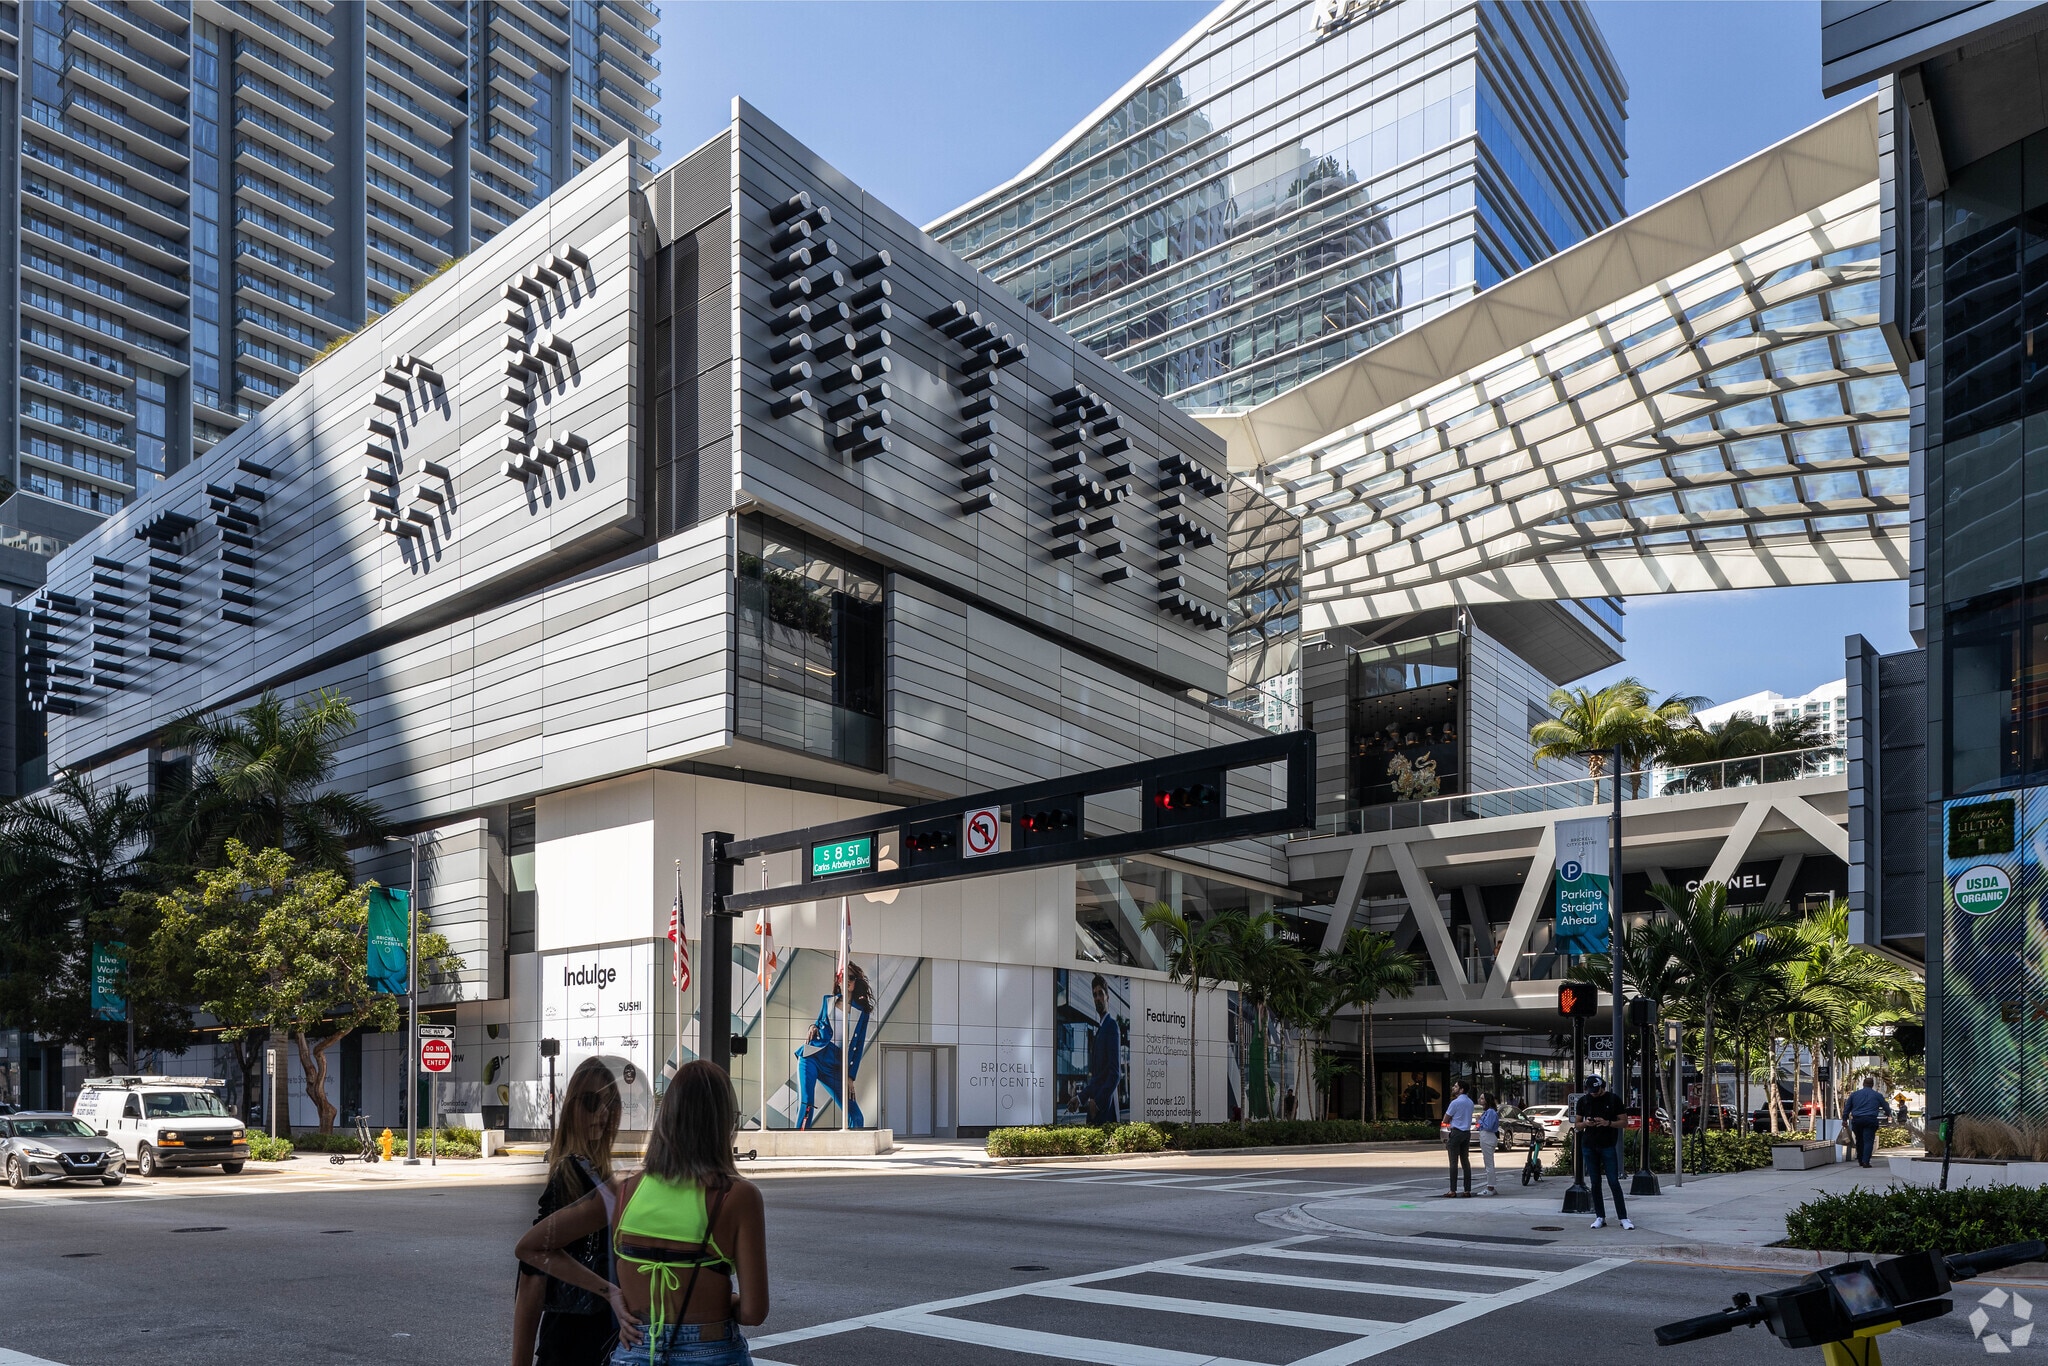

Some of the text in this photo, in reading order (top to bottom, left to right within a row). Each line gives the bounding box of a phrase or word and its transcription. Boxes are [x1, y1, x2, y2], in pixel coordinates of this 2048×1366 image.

[1957, 817, 2006, 832] ULTRA
[823, 844, 860, 861] S 8 ST
[814, 855, 870, 872] Carlos Arboleya Blvd
[1685, 874, 1767, 893] CNEL
[1966, 876, 1999, 890] USDA
[1561, 889, 1602, 900] Parking
[1961, 890, 2003, 904] ORGANIC
[1561, 901, 1603, 914] Straight
[1561, 914, 1597, 926] Ahead
[383, 940, 404, 948] CENTRE
[564, 963, 616, 990] Indulge
[618, 1001, 642, 1012] SUSHI
[1146, 1008, 1186, 1028] Featuring
[421, 1027, 432, 1035] ONE
[1146, 1033, 1161, 1043] Saks
[1146, 1044, 1188, 1056] CMX Cinema
[981, 1062, 1035, 1074] BRICKELL
[1146, 1068, 1165, 1080] Apple
[969, 1076, 1045, 1088] CITY CENTRE
[1146, 1079, 1162, 1089] Zara
[1146, 1095, 1186, 1106] and over 120
[1146, 1107, 1165, 1119] shops
[1165, 1107, 1178, 1117] and
